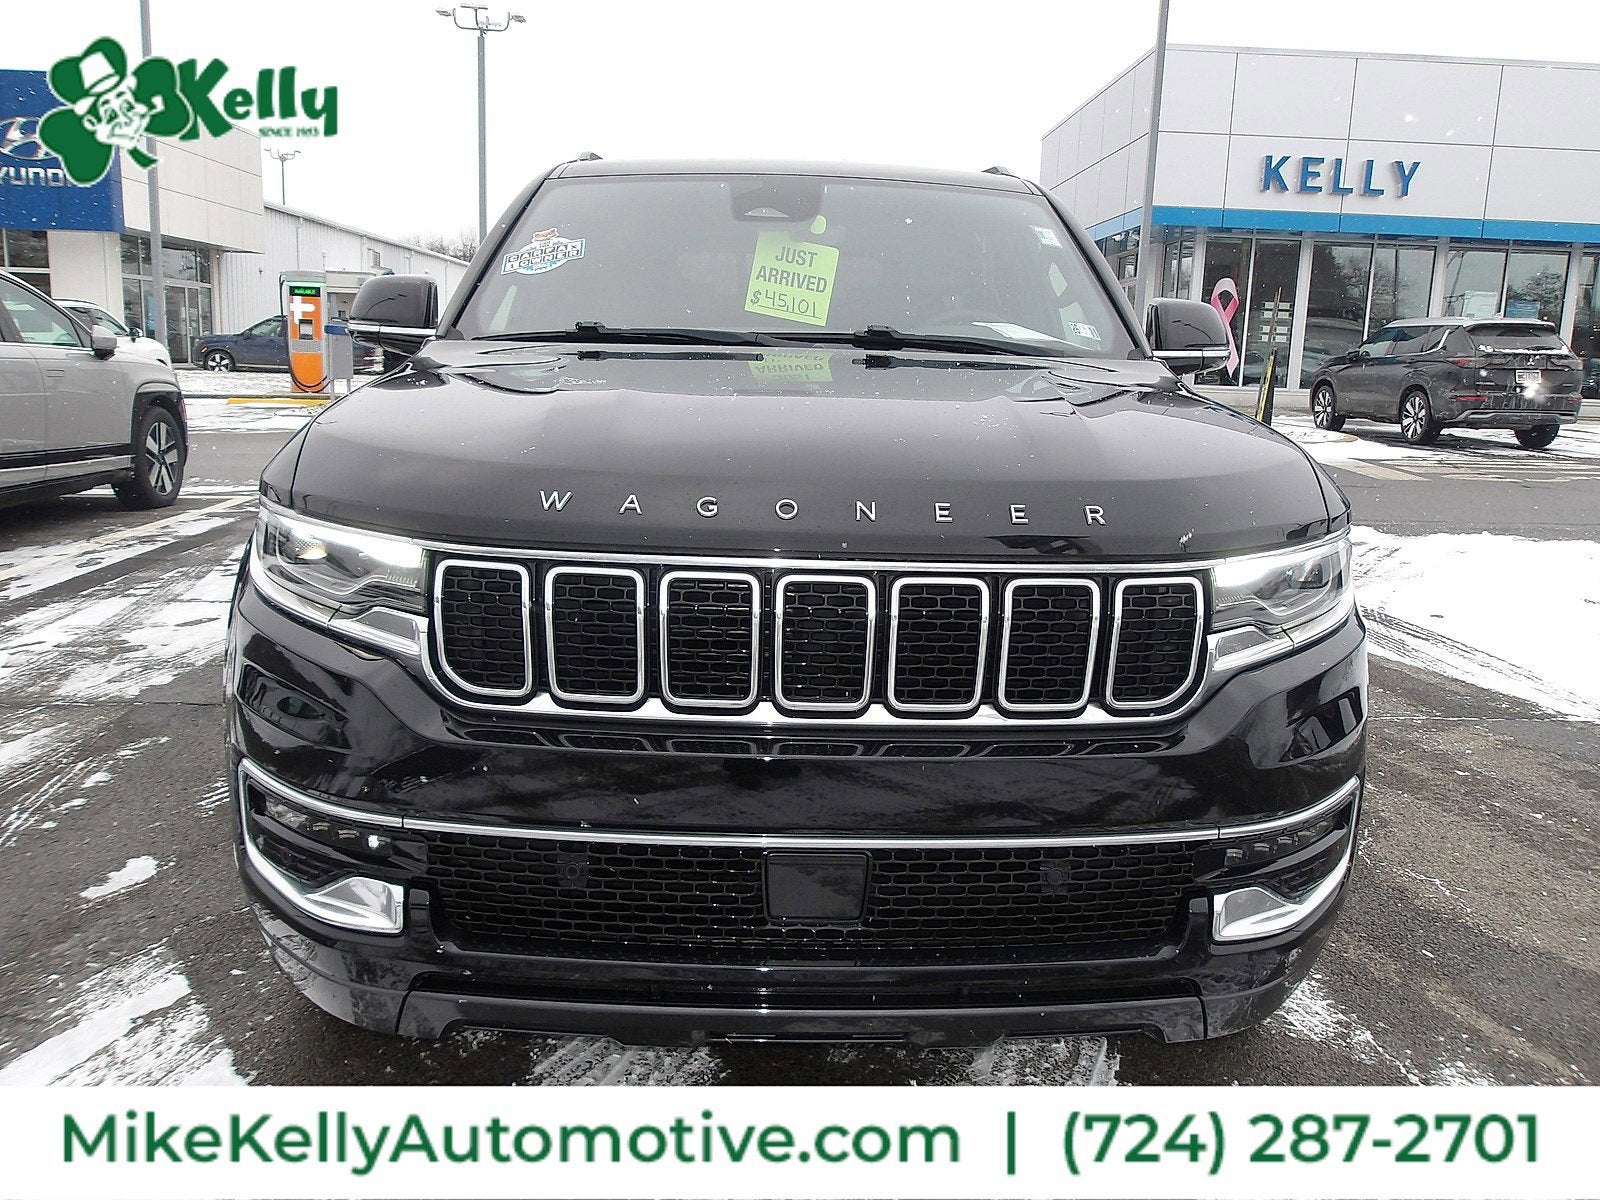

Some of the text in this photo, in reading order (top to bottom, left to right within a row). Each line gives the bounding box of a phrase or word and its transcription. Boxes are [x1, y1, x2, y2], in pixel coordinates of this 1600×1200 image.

[1262, 154, 1421, 197] KELLY
[775, 246, 818, 268] JUST
[755, 265, 828, 293] ARRIVED
[539, 490, 1106, 526] WAGONEER
